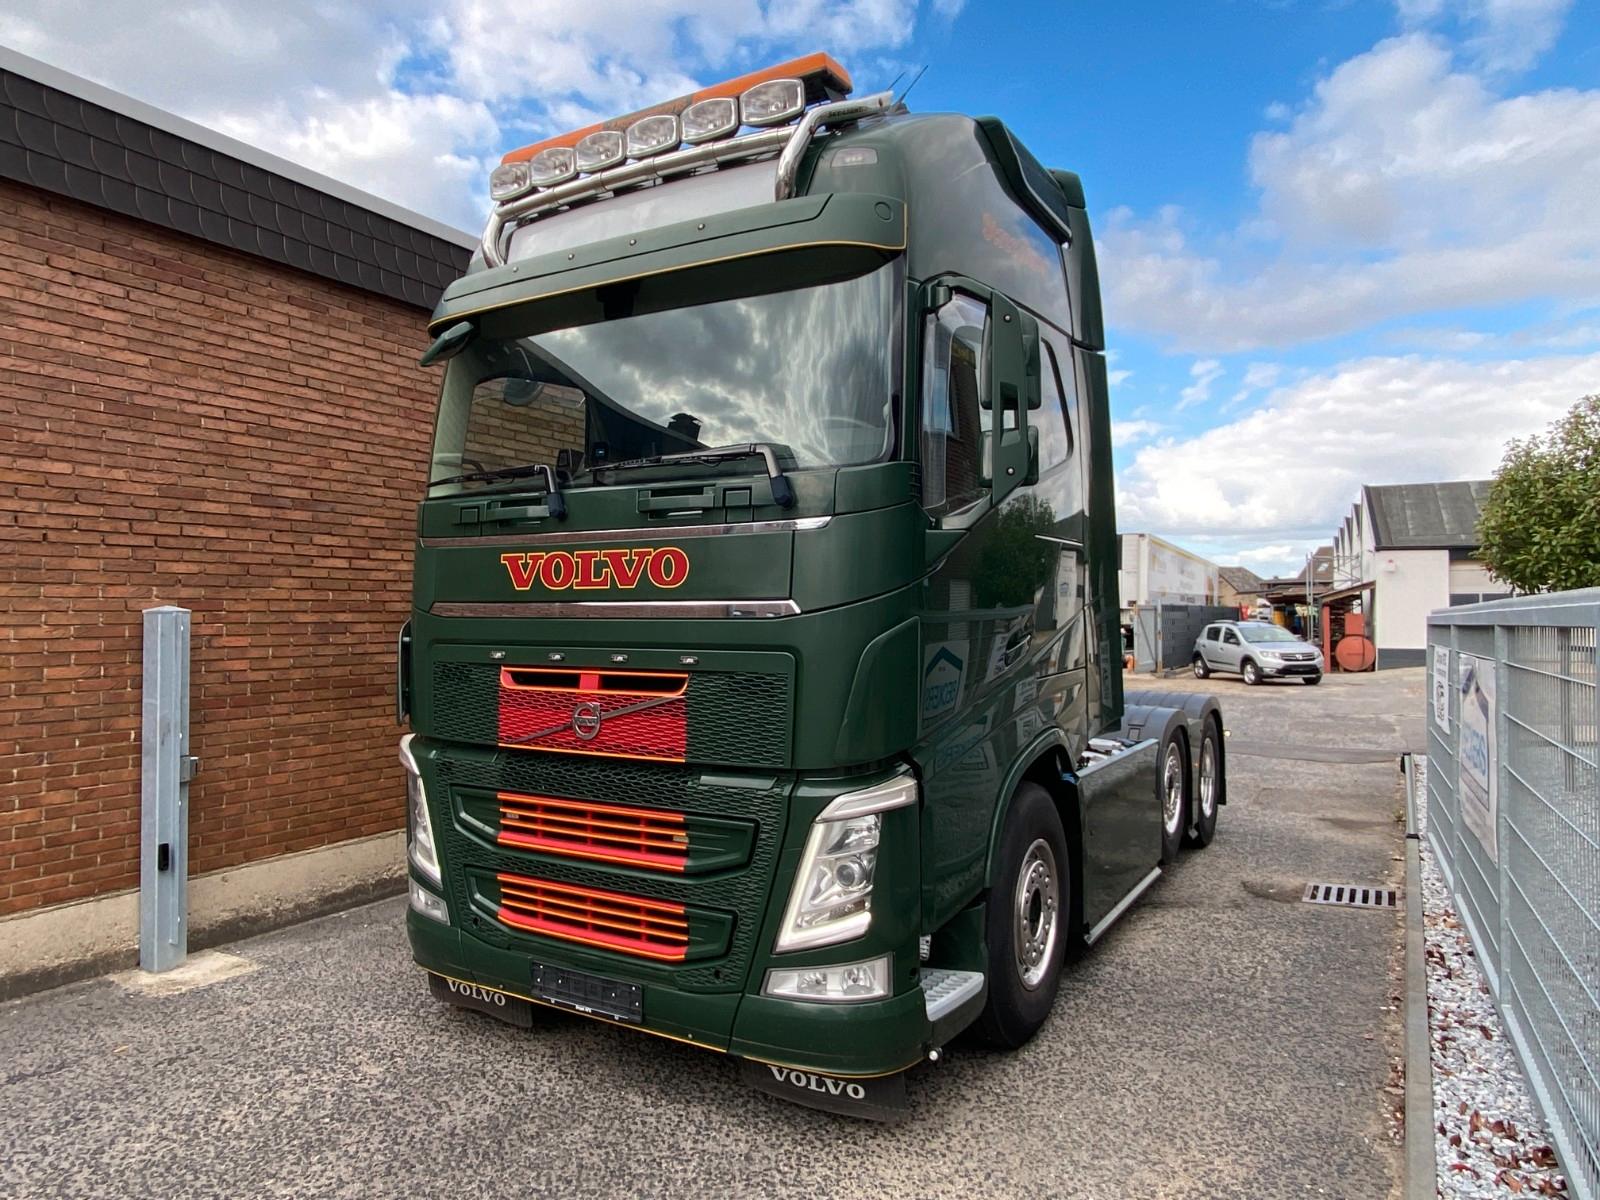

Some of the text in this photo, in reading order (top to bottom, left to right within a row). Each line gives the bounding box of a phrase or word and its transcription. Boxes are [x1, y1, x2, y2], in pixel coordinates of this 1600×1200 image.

[501, 547, 689, 590] VOLVO
[446, 978, 506, 1006] VOLVO
[768, 1065, 865, 1099] VOLVO
